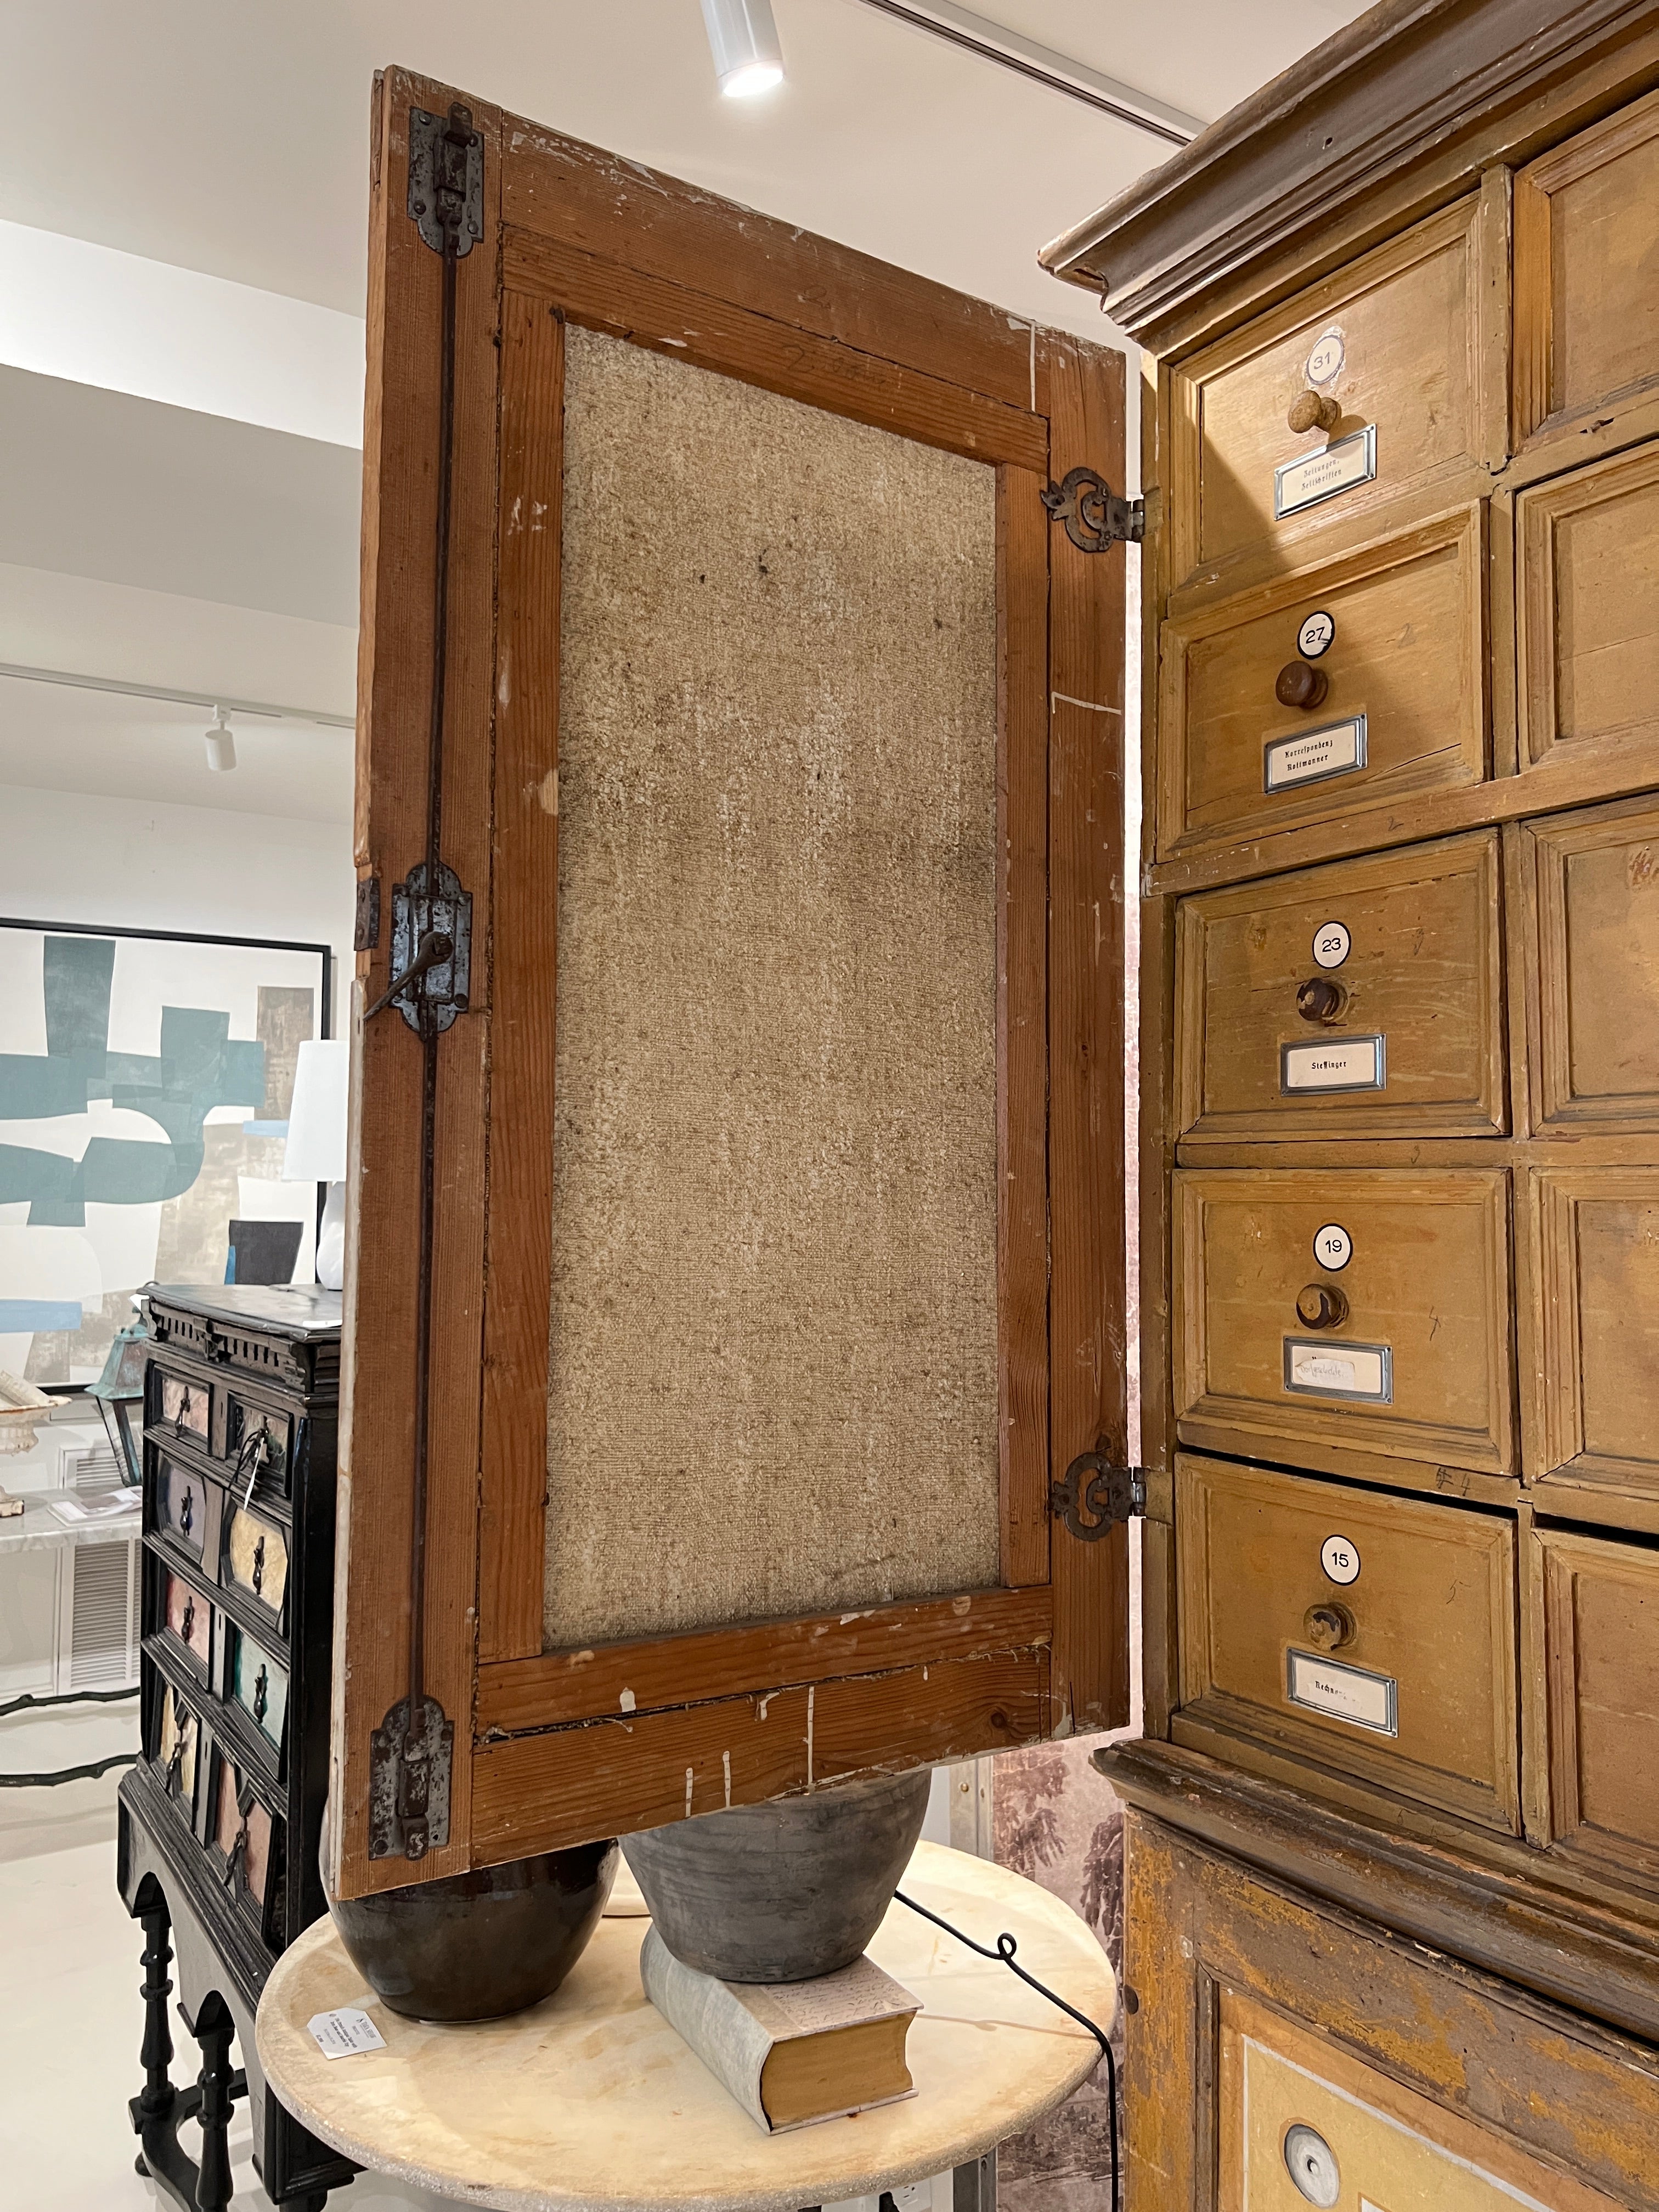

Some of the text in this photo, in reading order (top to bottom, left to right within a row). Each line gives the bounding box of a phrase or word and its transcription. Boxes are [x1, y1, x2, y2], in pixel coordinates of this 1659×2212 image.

[1314, 351, 1330, 370] 31
[1306, 627, 1325, 645] 27
[1322, 938, 1342, 953] 23
[1325, 1239, 1342, 1254] 19
[1331, 1552, 1350, 1568] 15
